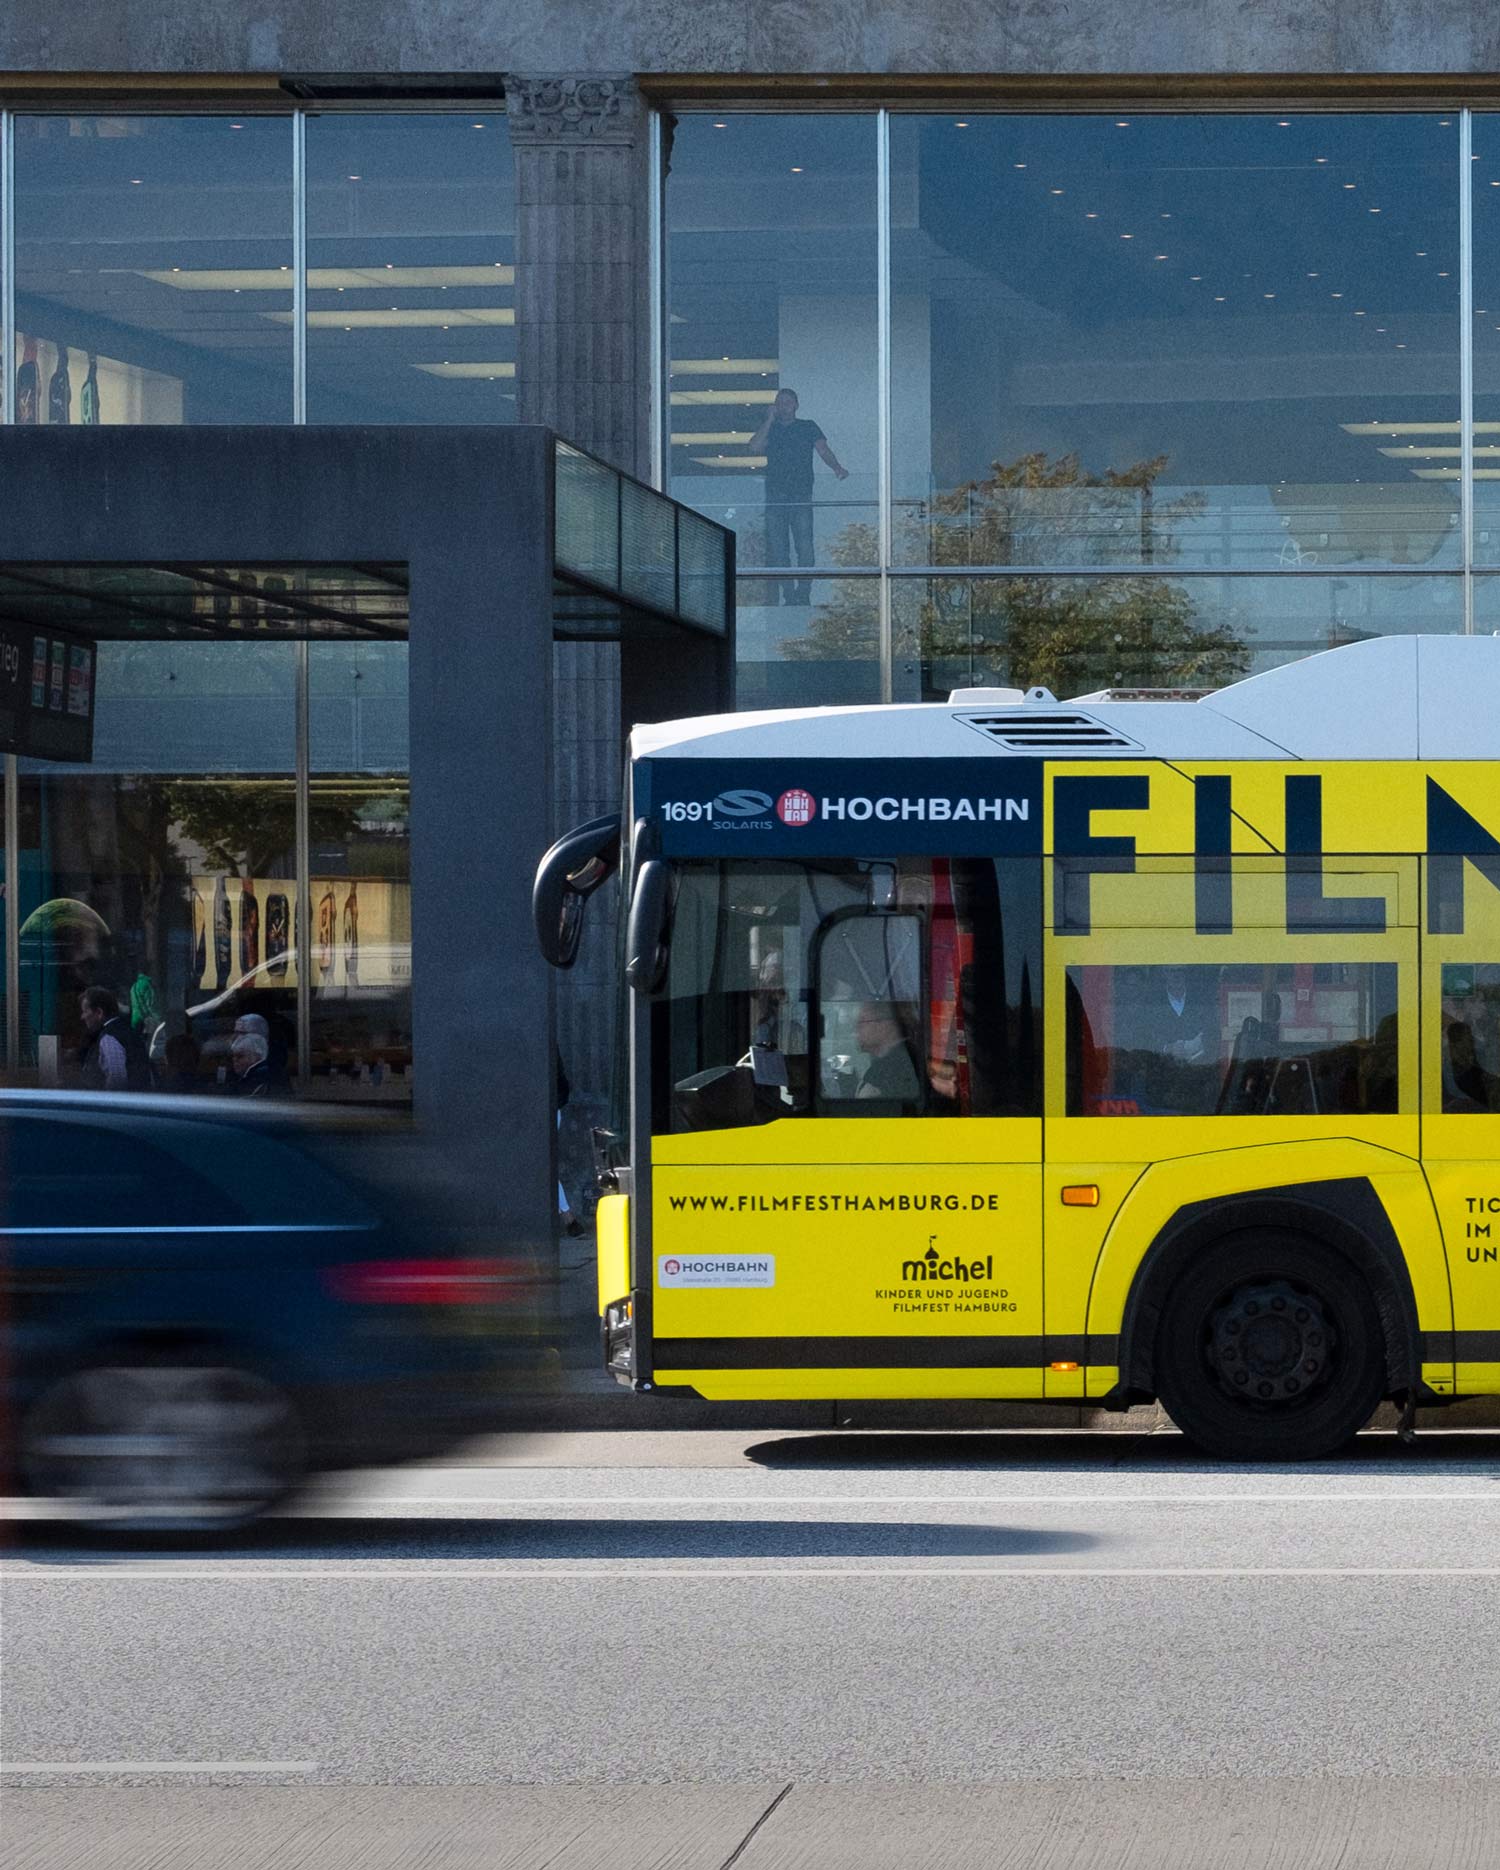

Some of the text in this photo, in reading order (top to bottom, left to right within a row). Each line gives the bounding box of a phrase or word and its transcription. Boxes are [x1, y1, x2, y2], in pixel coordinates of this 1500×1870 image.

[0, 632, 19, 683] ieg
[661, 801, 713, 822] 1691
[821, 797, 1029, 821] HOCHBAHN
[712, 820, 773, 830] SOLARIS
[669, 1194, 999, 1212] WWW.FILMFESTHAMBURG.DE
[1466, 1222, 1491, 1238] IM
[682, 1261, 769, 1273] HOCHBAHN
[902, 1253, 993, 1282] michel
[875, 1289, 1009, 1299] KINDER UND JUGEND
[893, 1302, 1017, 1313] FILMFEST HAMBURG
